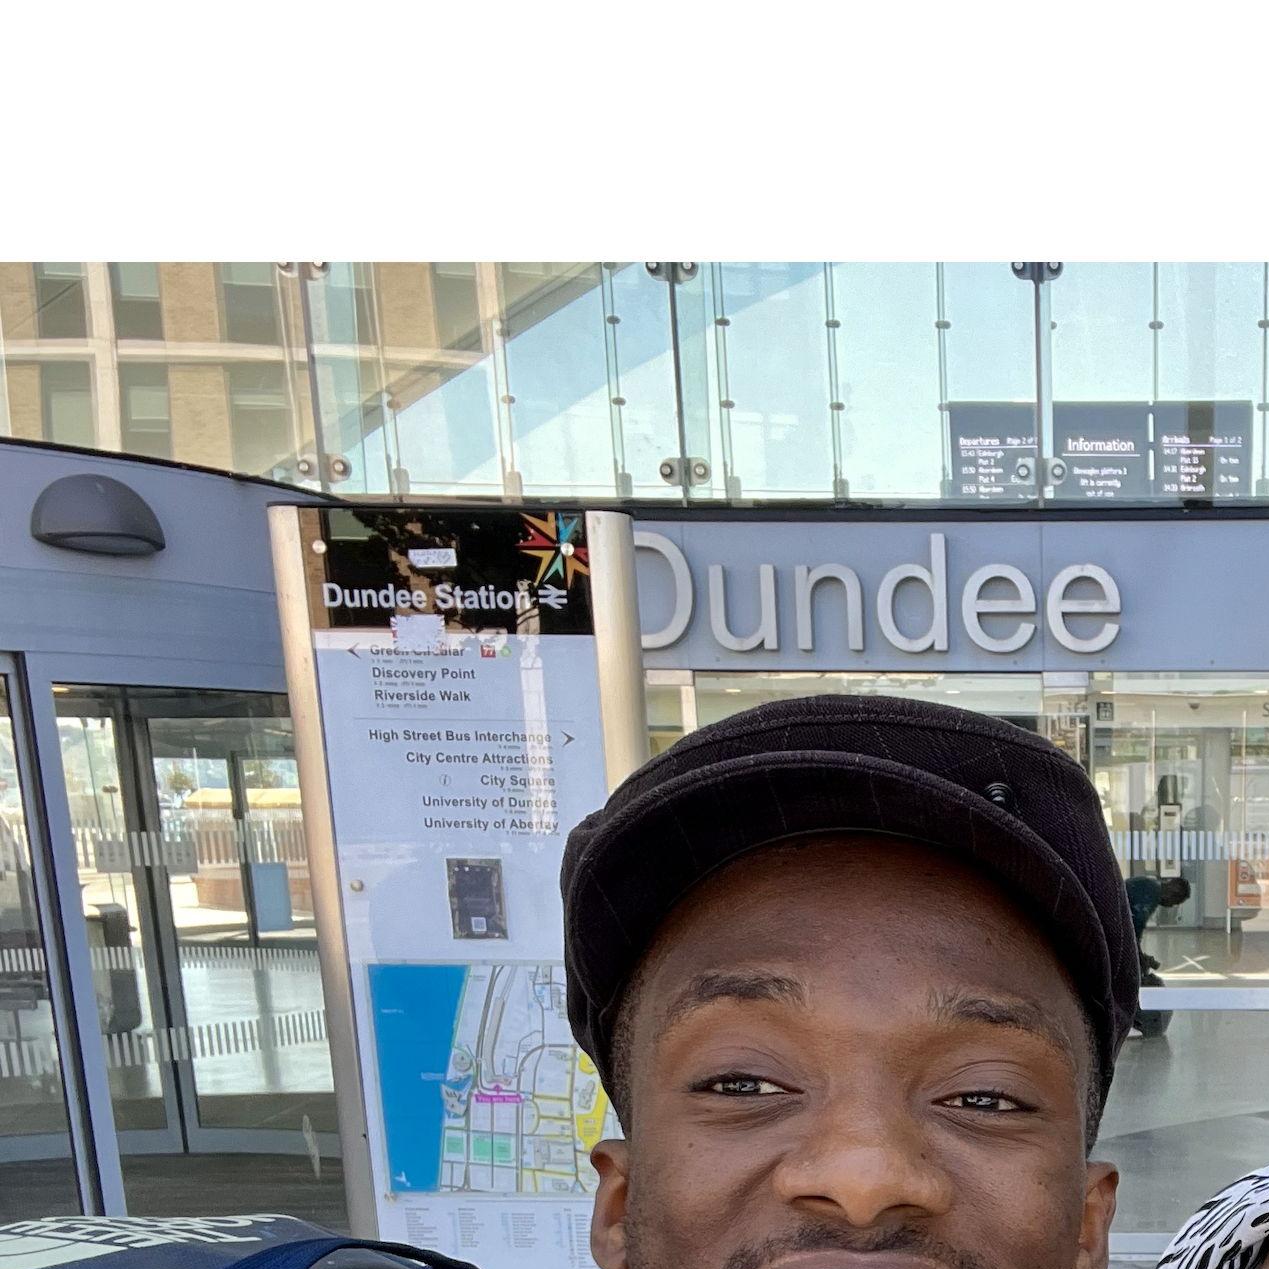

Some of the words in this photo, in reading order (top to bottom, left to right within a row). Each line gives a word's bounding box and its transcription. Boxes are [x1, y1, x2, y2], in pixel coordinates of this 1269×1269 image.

[959, 436, 1001, 446] Departures
[1067, 437, 1135, 452] Information
[322, 581, 428, 610] Dundee
[434, 584, 530, 611] Station
[635, 531, 1122, 654] Dundee
[372, 666, 437, 681] Discovery
[441, 667, 476, 680] Point
[374, 689, 436, 701] Riverside
[440, 690, 472, 701] Walk
[368, 729, 399, 743] High
[403, 729, 441, 741] Street
[445, 730, 471, 742] Bus
[474, 731, 551, 745] Interchange
[406, 751, 431, 766] City
[436, 752, 479, 763] Centre
[482, 753, 553, 765] Attractions
[480, 774, 506, 788] City
[510, 774, 556, 788] Square
[422, 795, 488, 810] University
[491, 796, 505, 808] of
[508, 797, 557, 808] Dundee
[424, 817, 489, 831] University
[493, 818, 506, 829] of
